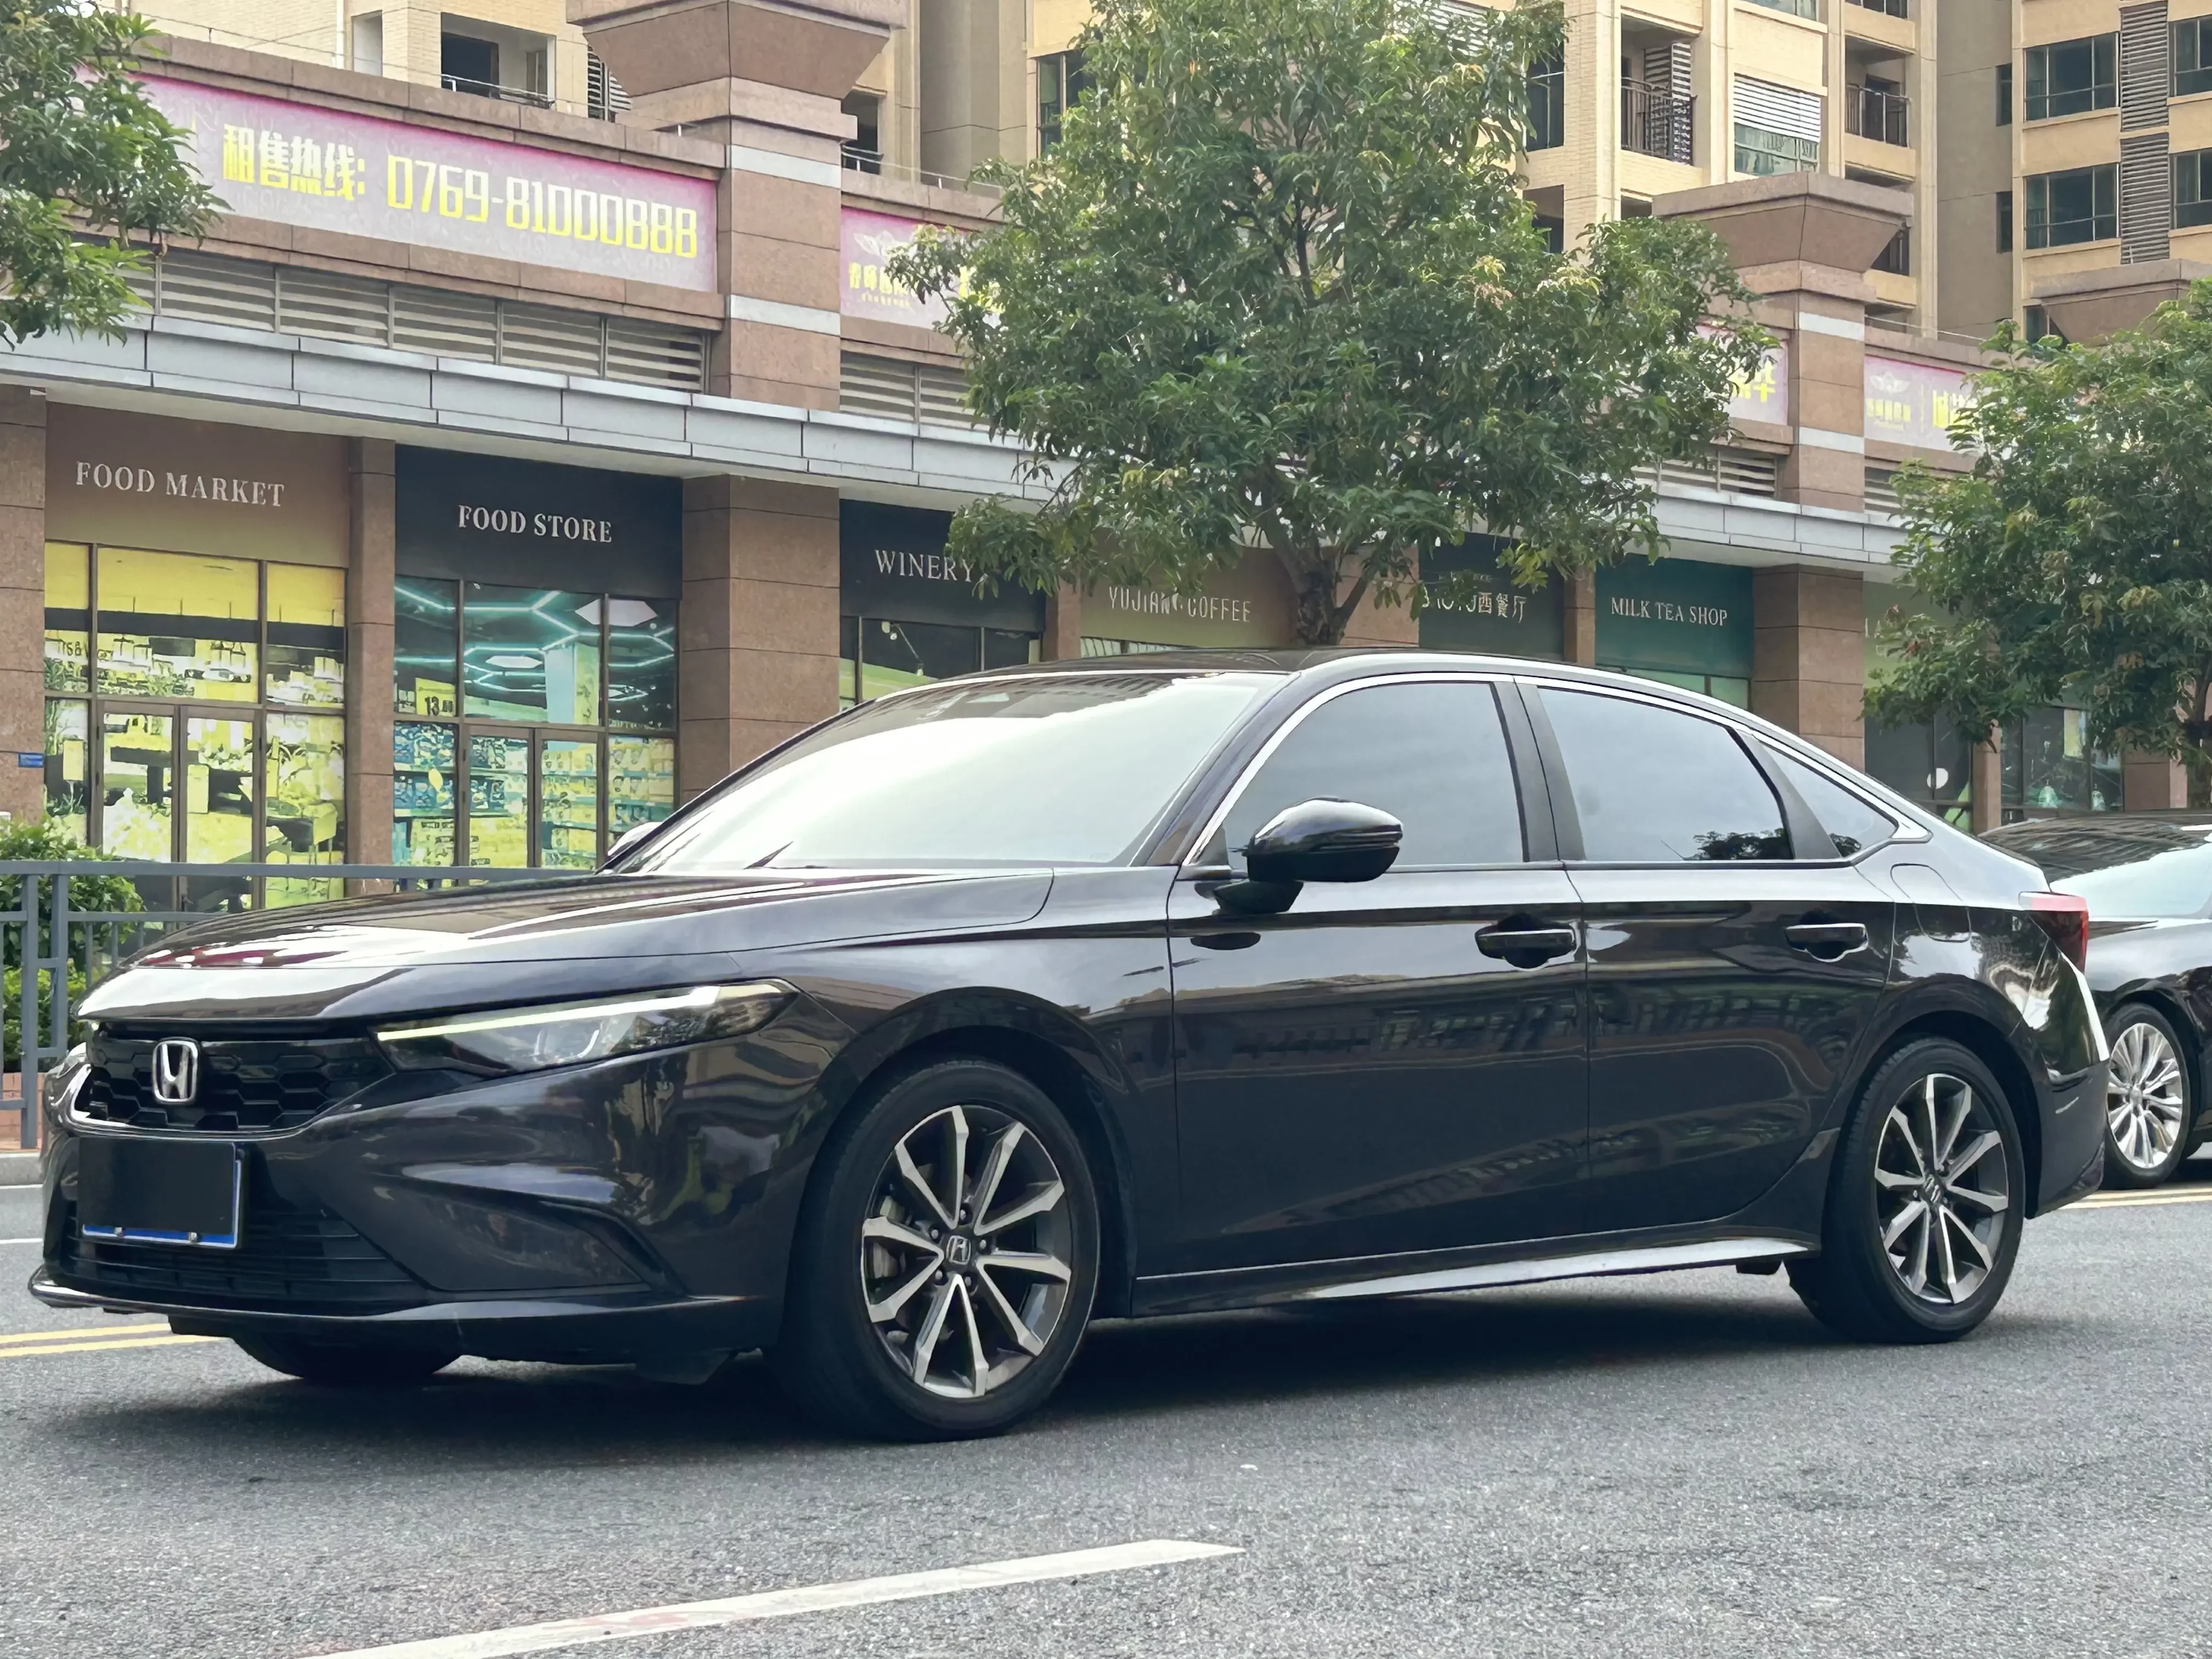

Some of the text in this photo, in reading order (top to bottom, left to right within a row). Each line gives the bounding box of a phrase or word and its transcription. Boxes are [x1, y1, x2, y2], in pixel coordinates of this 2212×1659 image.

[387, 154, 697, 258] 0769-81000888
[76, 461, 285, 506] FOOD MARKET
[459, 505, 612, 543] FOOD STORE
[874, 549, 975, 582] WINERY
[1188, 596, 1251, 622] COFFEE
[1611, 597, 1728, 627] MILK TEA SHOP
